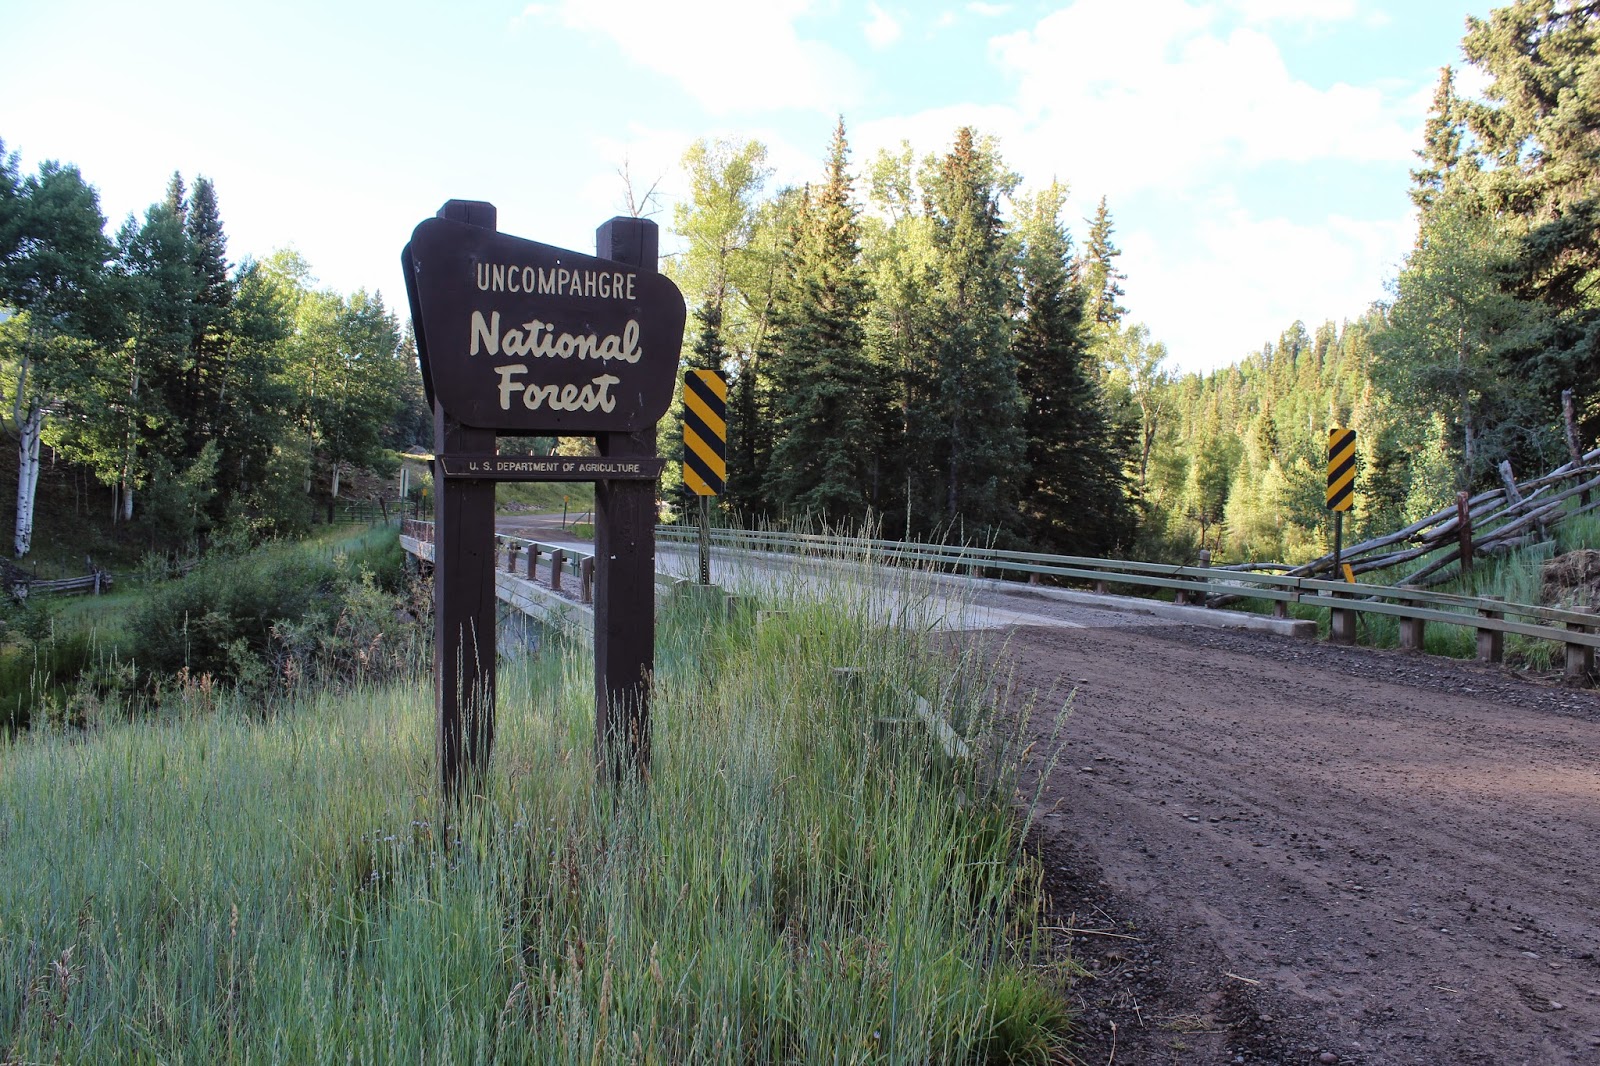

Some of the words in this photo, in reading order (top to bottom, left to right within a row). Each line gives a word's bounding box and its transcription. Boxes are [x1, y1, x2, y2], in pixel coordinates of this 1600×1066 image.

[477, 262, 637, 300] UNCOMPAHGRE
[469, 310, 643, 364] National
[494, 364, 620, 414] Forest
[496, 461, 560, 473] DEPARTMENT
[562, 462, 575, 473] OF
[579, 462, 640, 474] AGRICULTURE
